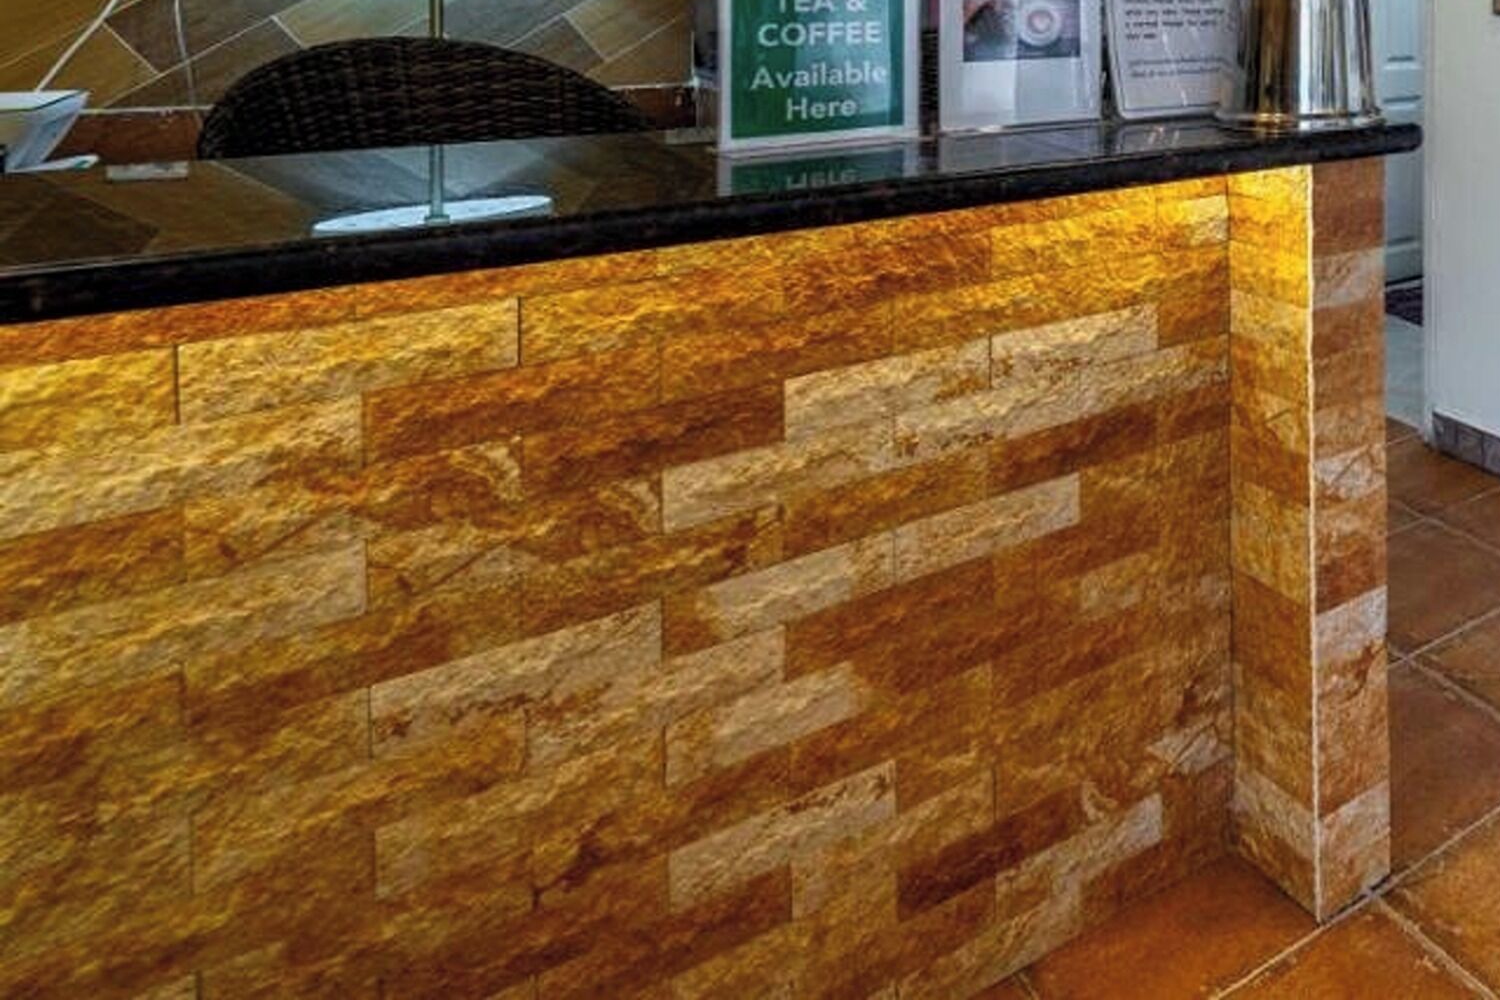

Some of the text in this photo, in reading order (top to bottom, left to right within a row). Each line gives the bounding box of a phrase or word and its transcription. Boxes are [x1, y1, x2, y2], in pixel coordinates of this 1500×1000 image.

[757, 22, 883, 47] COFFEE
[750, 60, 888, 91] Available
[785, 97, 859, 122] Here
